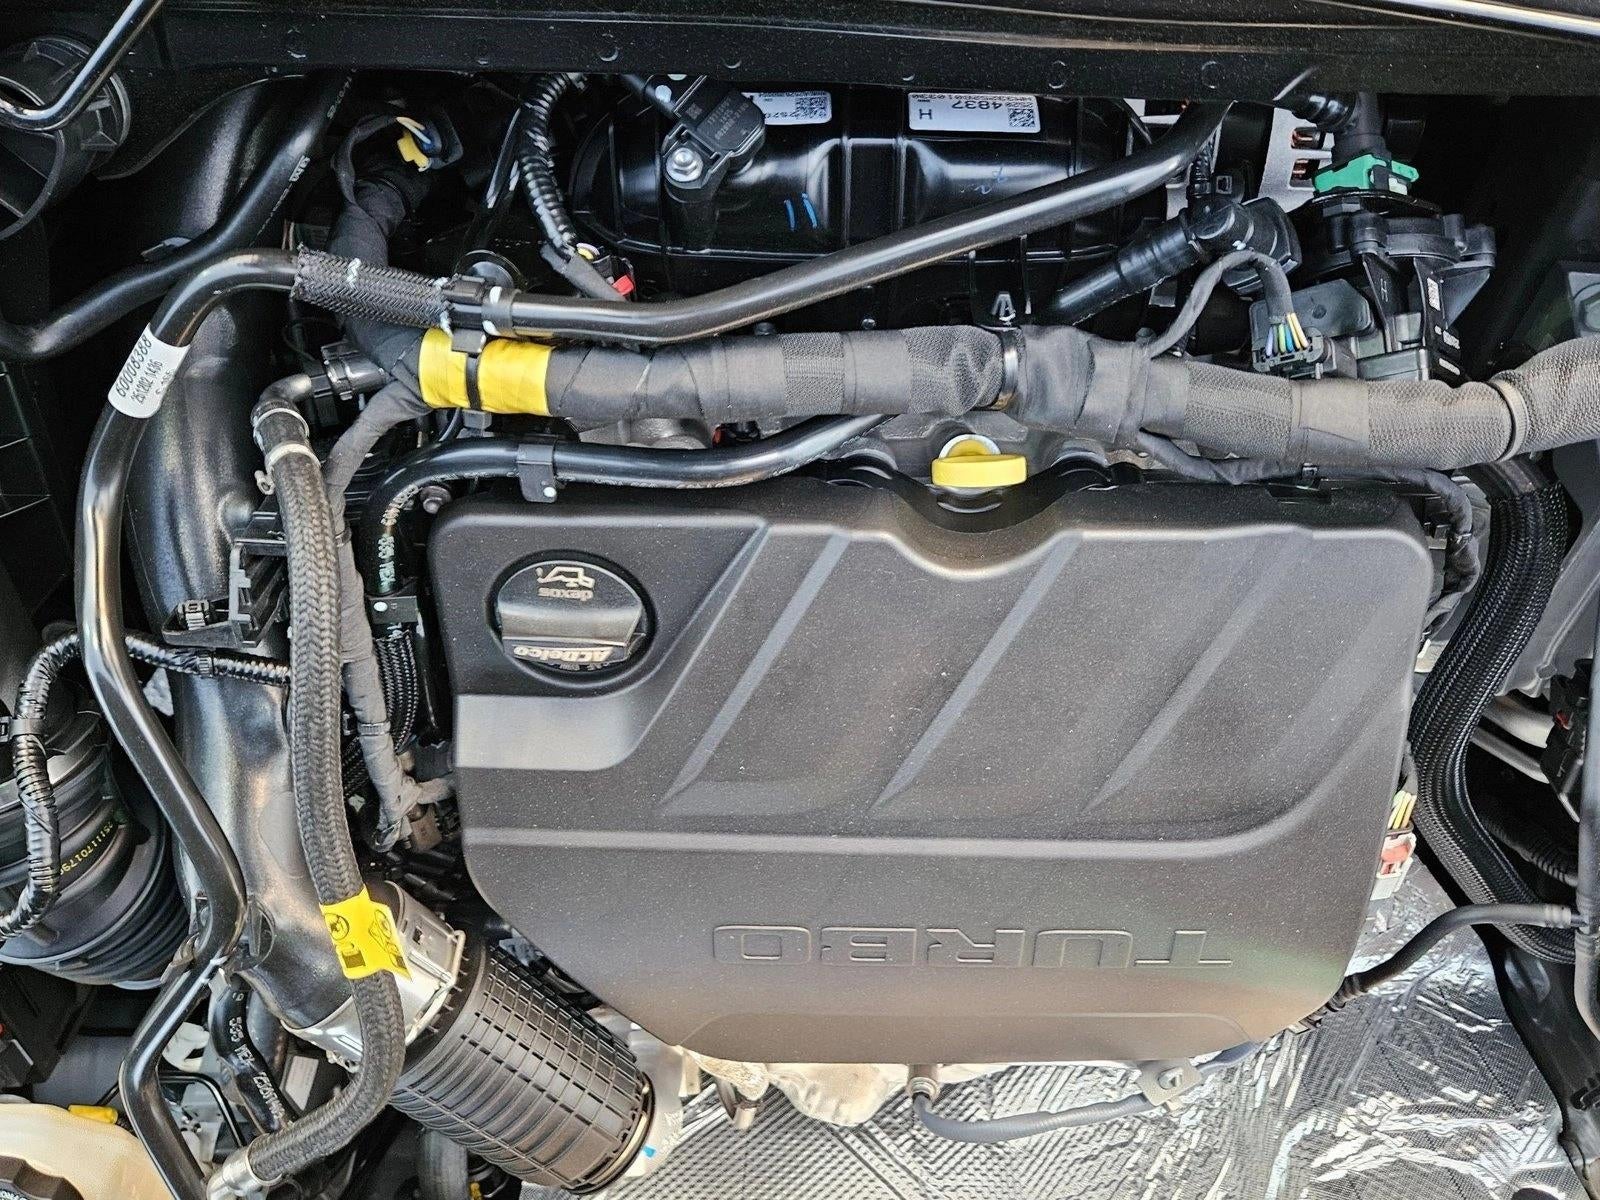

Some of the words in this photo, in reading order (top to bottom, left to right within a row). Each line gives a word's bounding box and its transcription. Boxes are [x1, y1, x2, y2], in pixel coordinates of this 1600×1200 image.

[951, 101, 1002, 110] 4837
[918, 109, 932, 120] H
[116, 334, 152, 397] 60008388
[512, 645, 612, 662] ACDelco
[712, 925, 1233, 968] TURBO
